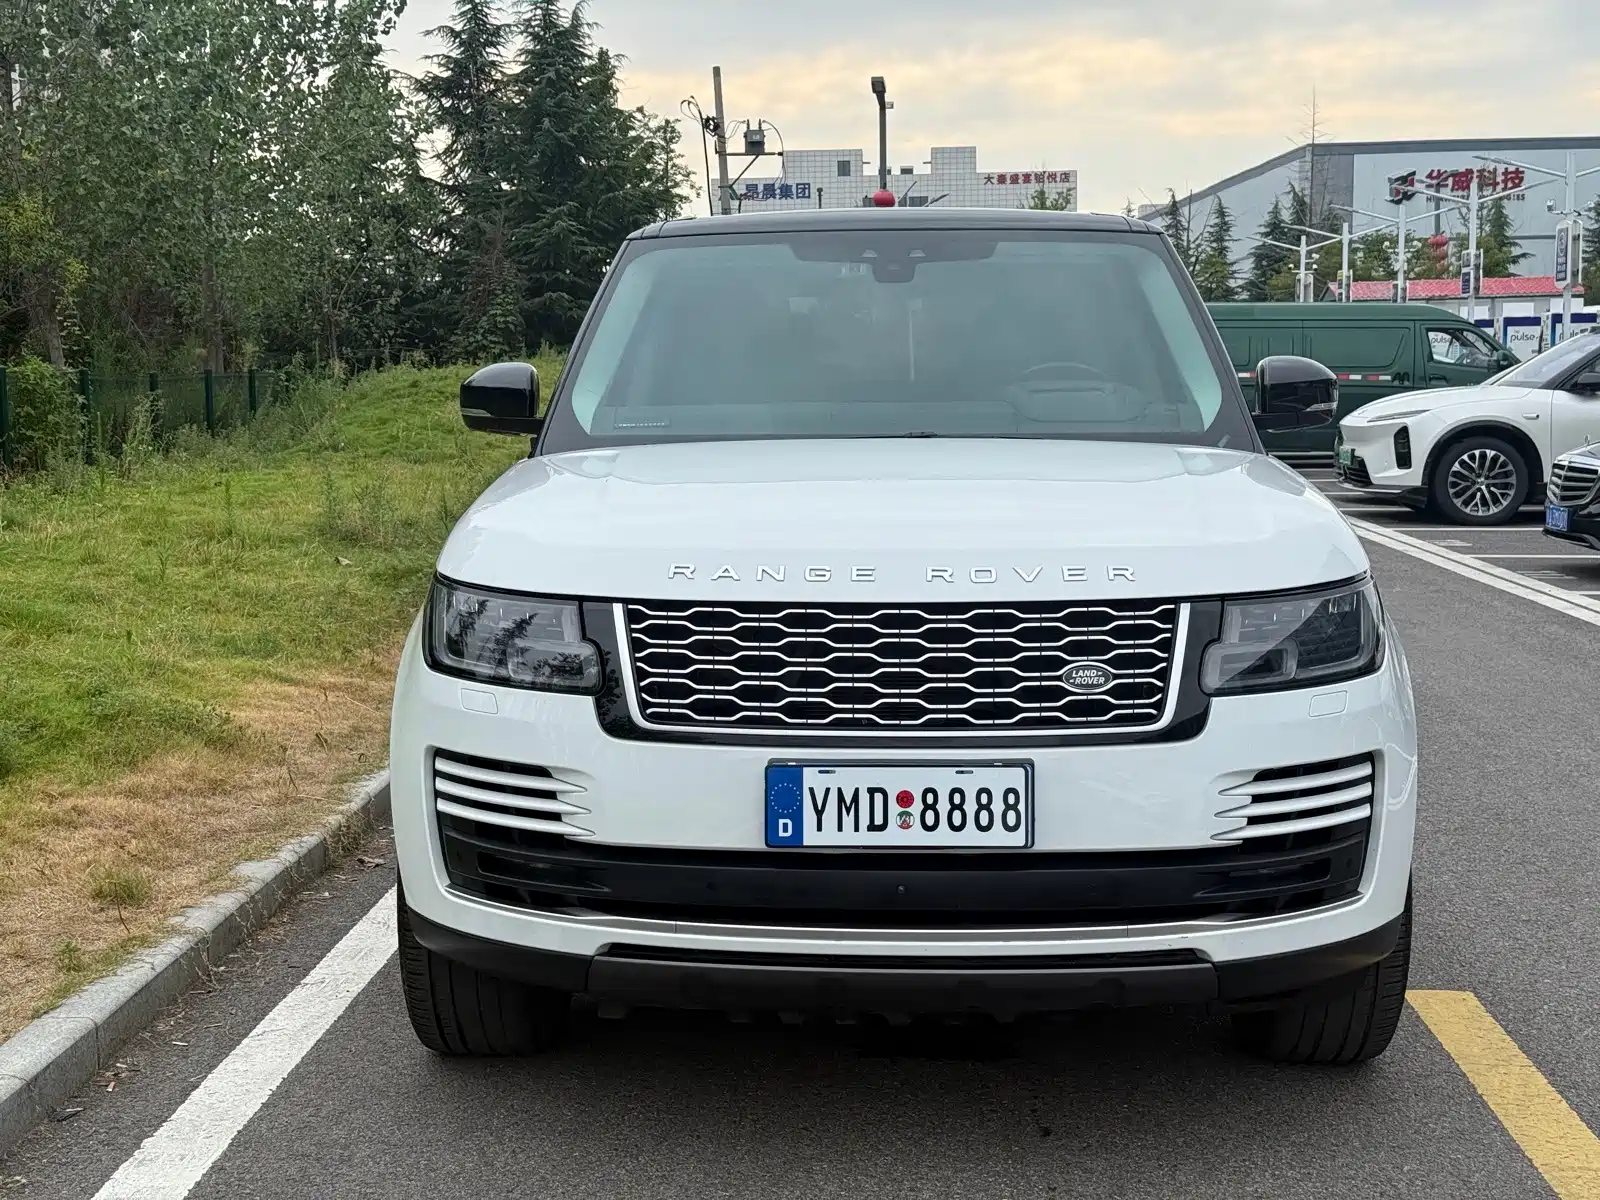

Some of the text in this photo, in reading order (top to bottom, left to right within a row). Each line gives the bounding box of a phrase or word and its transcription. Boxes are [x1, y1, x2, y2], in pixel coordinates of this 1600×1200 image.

[1425, 167, 1525, 193] 华威科技
[1510, 331, 1536, 344] pulse
[668, 563, 1137, 584] RANGE ROVER
[808, 787, 1022, 833] YMD 8888
[778, 818, 793, 837] D
